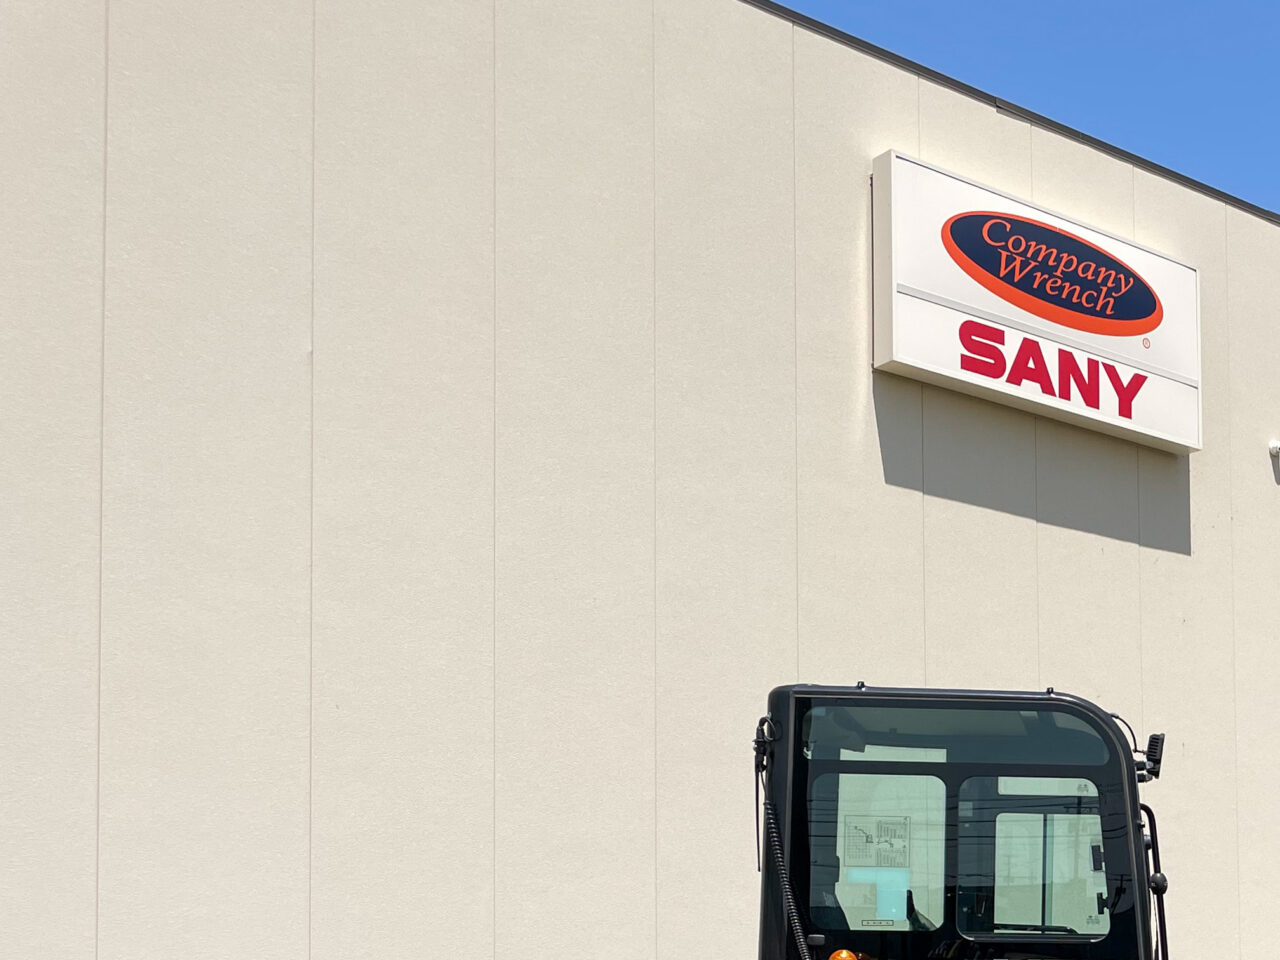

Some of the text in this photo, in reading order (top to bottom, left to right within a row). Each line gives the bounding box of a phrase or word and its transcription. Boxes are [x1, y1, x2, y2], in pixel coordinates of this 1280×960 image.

[981, 218, 1134, 297] Company
[997, 248, 1116, 315] Wrench
[958, 319, 1148, 420] SANY
